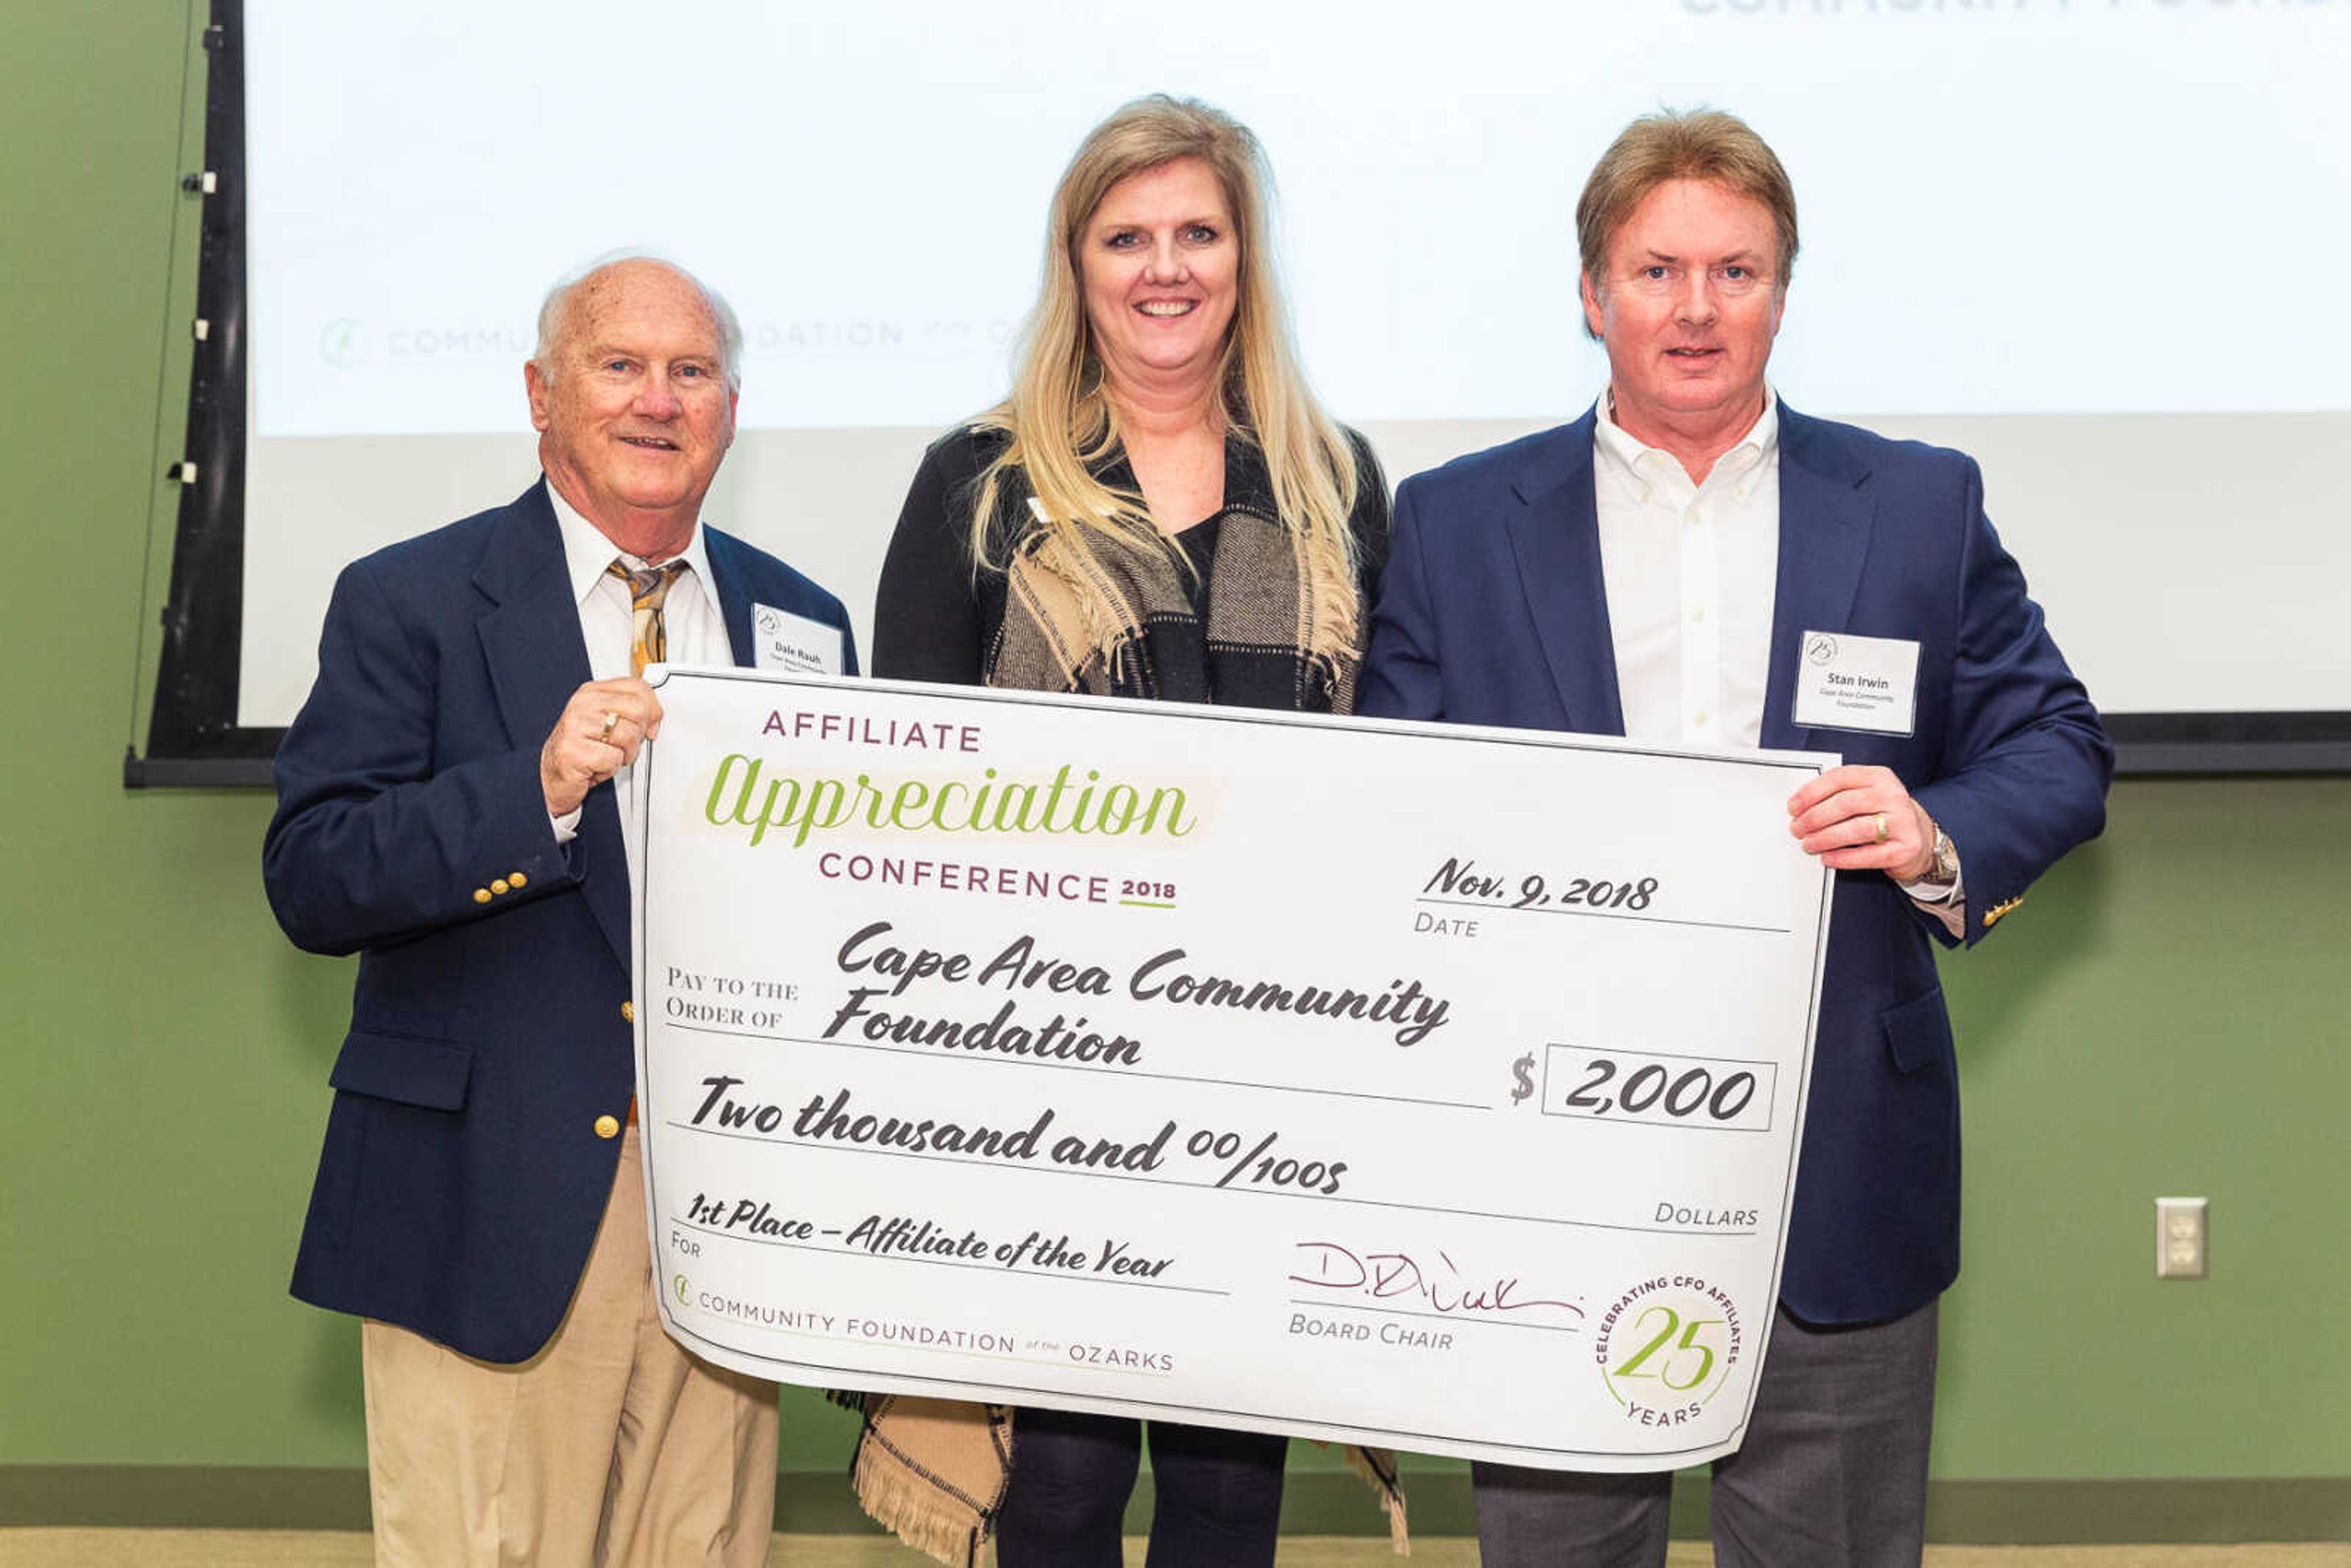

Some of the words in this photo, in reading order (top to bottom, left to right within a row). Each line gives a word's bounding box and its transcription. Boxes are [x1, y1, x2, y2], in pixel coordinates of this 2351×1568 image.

[388, 329, 531, 354] COMMU
[775, 640, 795, 655] Dale
[798, 649, 822, 664] Rauh
[1827, 672, 1855, 686] Stan
[1858, 676, 1889, 689] Irwin
[762, 710, 981, 752] AFFILIATE
[705, 753, 1198, 847] Appreciation
[819, 852, 1109, 902] CONFERENCE
[1122, 880, 1177, 899] 2018
[1423, 857, 1505, 899] Nov.
[1511, 875, 1551, 909] 9,
[1562, 877, 1659, 911] 2018
[837, 921, 972, 997] Cape
[978, 935, 1113, 997] Area
[1129, 948, 1450, 1048] Community
[822, 986, 1141, 1066] Foundation
[1510, 1051, 1536, 1106] $
[1565, 1059, 1756, 1121] 2,000
[691, 1075, 782, 1133] Two
[793, 1087, 1055, 1160] thousand
[1051, 1119, 1177, 1172] and
[688, 1192, 727, 1225] 1st
[724, 1198, 814, 1240] Place
[846, 1214, 989, 1259] Affiliate
[994, 1231, 1040, 1268] of
[1032, 1234, 1087, 1271] the
[1093, 1239, 1175, 1278] Year
[699, 1292, 835, 1332] COMMUNITY
[847, 1318, 1015, 1354] FOUNDATION
[1069, 1344, 1174, 1371] OZARKS
[1596, 1276, 1669, 1365] CELEBRATING
[1673, 1275, 1705, 1291] CFO
[1707, 1286, 1741, 1365] AFFILIATES
[1613, 1305, 1728, 1390] 25
[1627, 1401, 1703, 1428] YEARS
